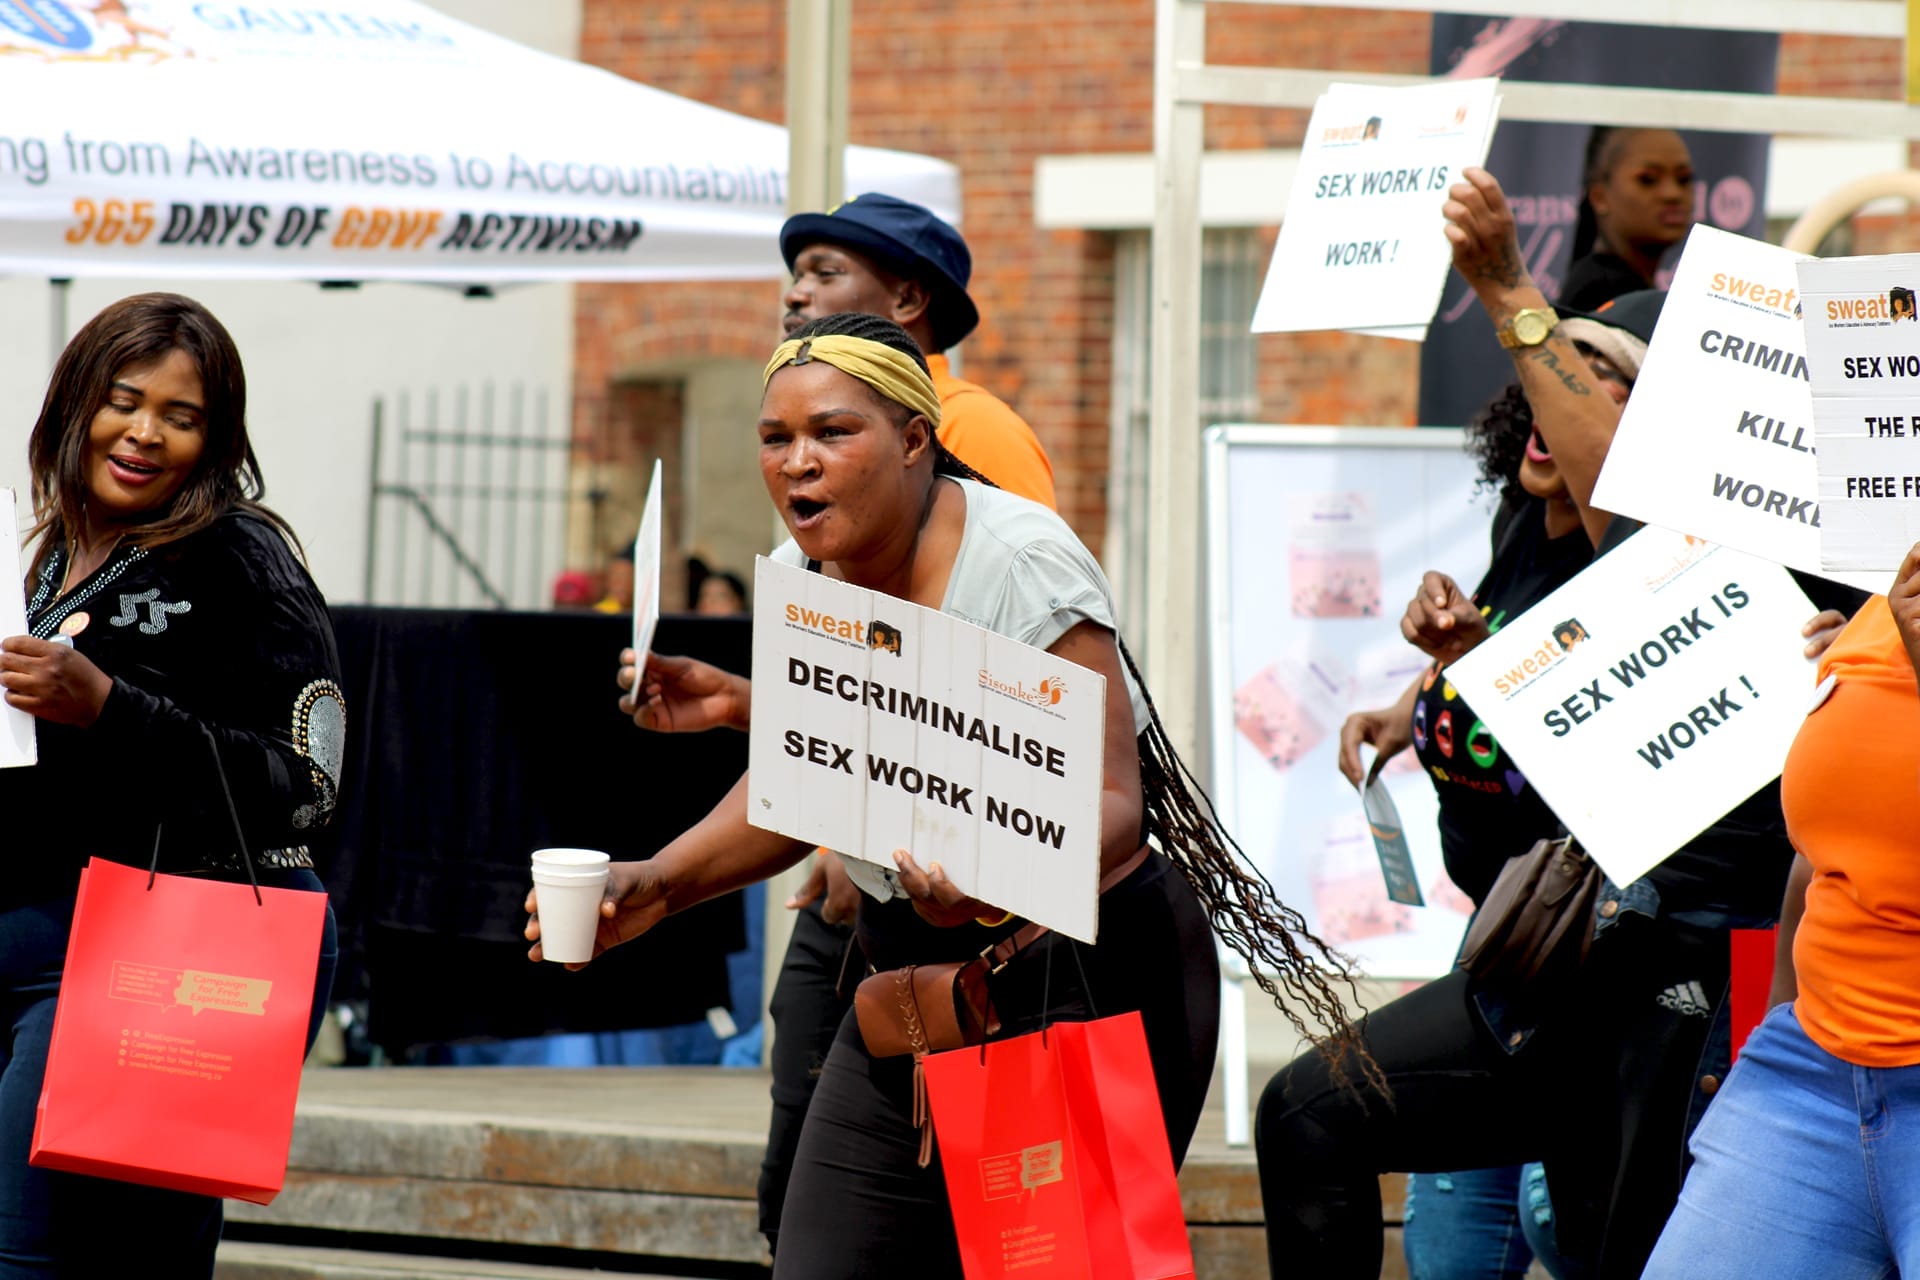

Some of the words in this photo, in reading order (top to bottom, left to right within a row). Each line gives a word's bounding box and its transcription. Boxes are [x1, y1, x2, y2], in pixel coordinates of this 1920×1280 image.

[65, 131, 171, 175] from
[186, 137, 437, 187] Awareness
[449, 151, 493, 190] to
[506, 151, 786, 205] Accountabilit
[1315, 172, 1356, 198] SEX
[1361, 167, 1423, 195] WORK
[1427, 166, 1448, 190] IS
[64, 197, 155, 246] 365
[158, 202, 270, 247] DAYS
[274, 205, 330, 248] OF
[331, 205, 444, 250] GBVF
[440, 211, 643, 252] ACTIVISM
[1325, 241, 1386, 266] WORK
[1711, 273, 1796, 312] sweat
[1827, 293, 1888, 320] sweat
[1700, 329, 1810, 382] CRIMIN
[1844, 357, 1883, 379] SEX
[1736, 410, 1816, 455] KILL
[1865, 417, 1905, 438] THE
[1847, 477, 1896, 498] FREE
[785, 603, 865, 643] sweat
[1494, 640, 1561, 695] sweat
[1543, 678, 1614, 737] SEX
[1608, 606, 1715, 690] WORK
[1711, 582, 1750, 618] IS
[978, 669, 1034, 702] Sisonke
[788, 657, 1065, 777] DECRIMINALISE
[1636, 687, 1743, 770] WORK
[1739, 674, 1761, 699] !
[784, 729, 854, 775] SEX
[867, 754, 973, 815] WORK
[986, 796, 1065, 850] NOW
